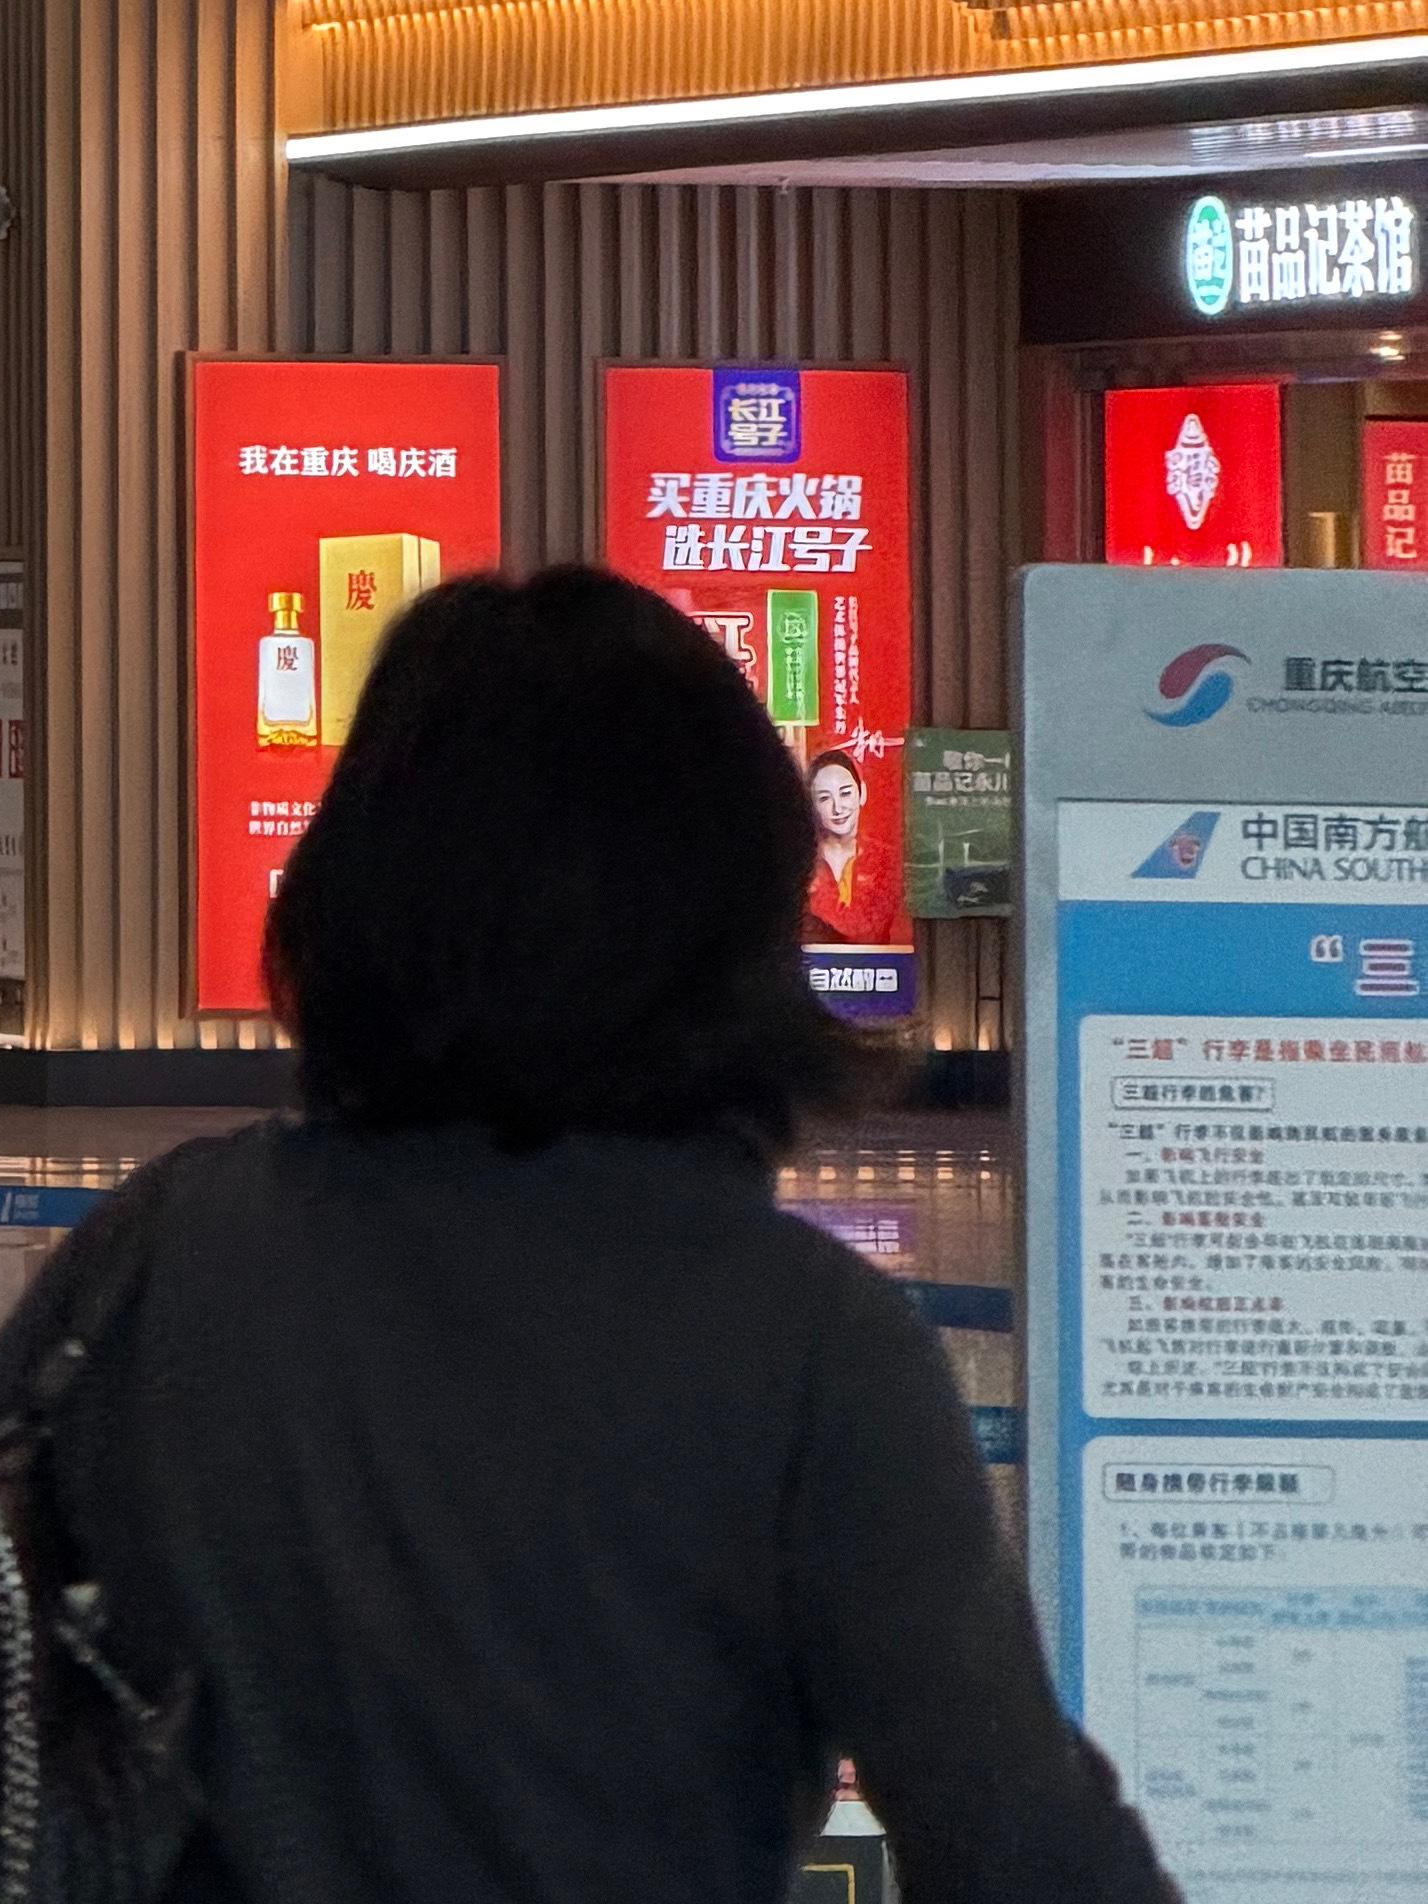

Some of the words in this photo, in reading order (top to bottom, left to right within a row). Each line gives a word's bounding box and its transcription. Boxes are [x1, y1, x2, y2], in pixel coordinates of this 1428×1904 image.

[1235, 196, 1414, 304] 苗品记茶馆
[728, 397, 787, 422] 长江
[728, 422, 788, 447] 号子
[238, 444, 360, 477] 我在重庆
[367, 446, 458, 479] 喝庆酒
[646, 472, 863, 521] 买重庆火锅
[1382, 451, 1418, 560] 苗品记
[662, 524, 873, 573] 选长江号子
[1284, 656, 1428, 693] 重庆航空
[249, 800, 322, 817] 非物质文化
[248, 820, 310, 836] 世界自然
[1241, 856, 1327, 881] CHINA
